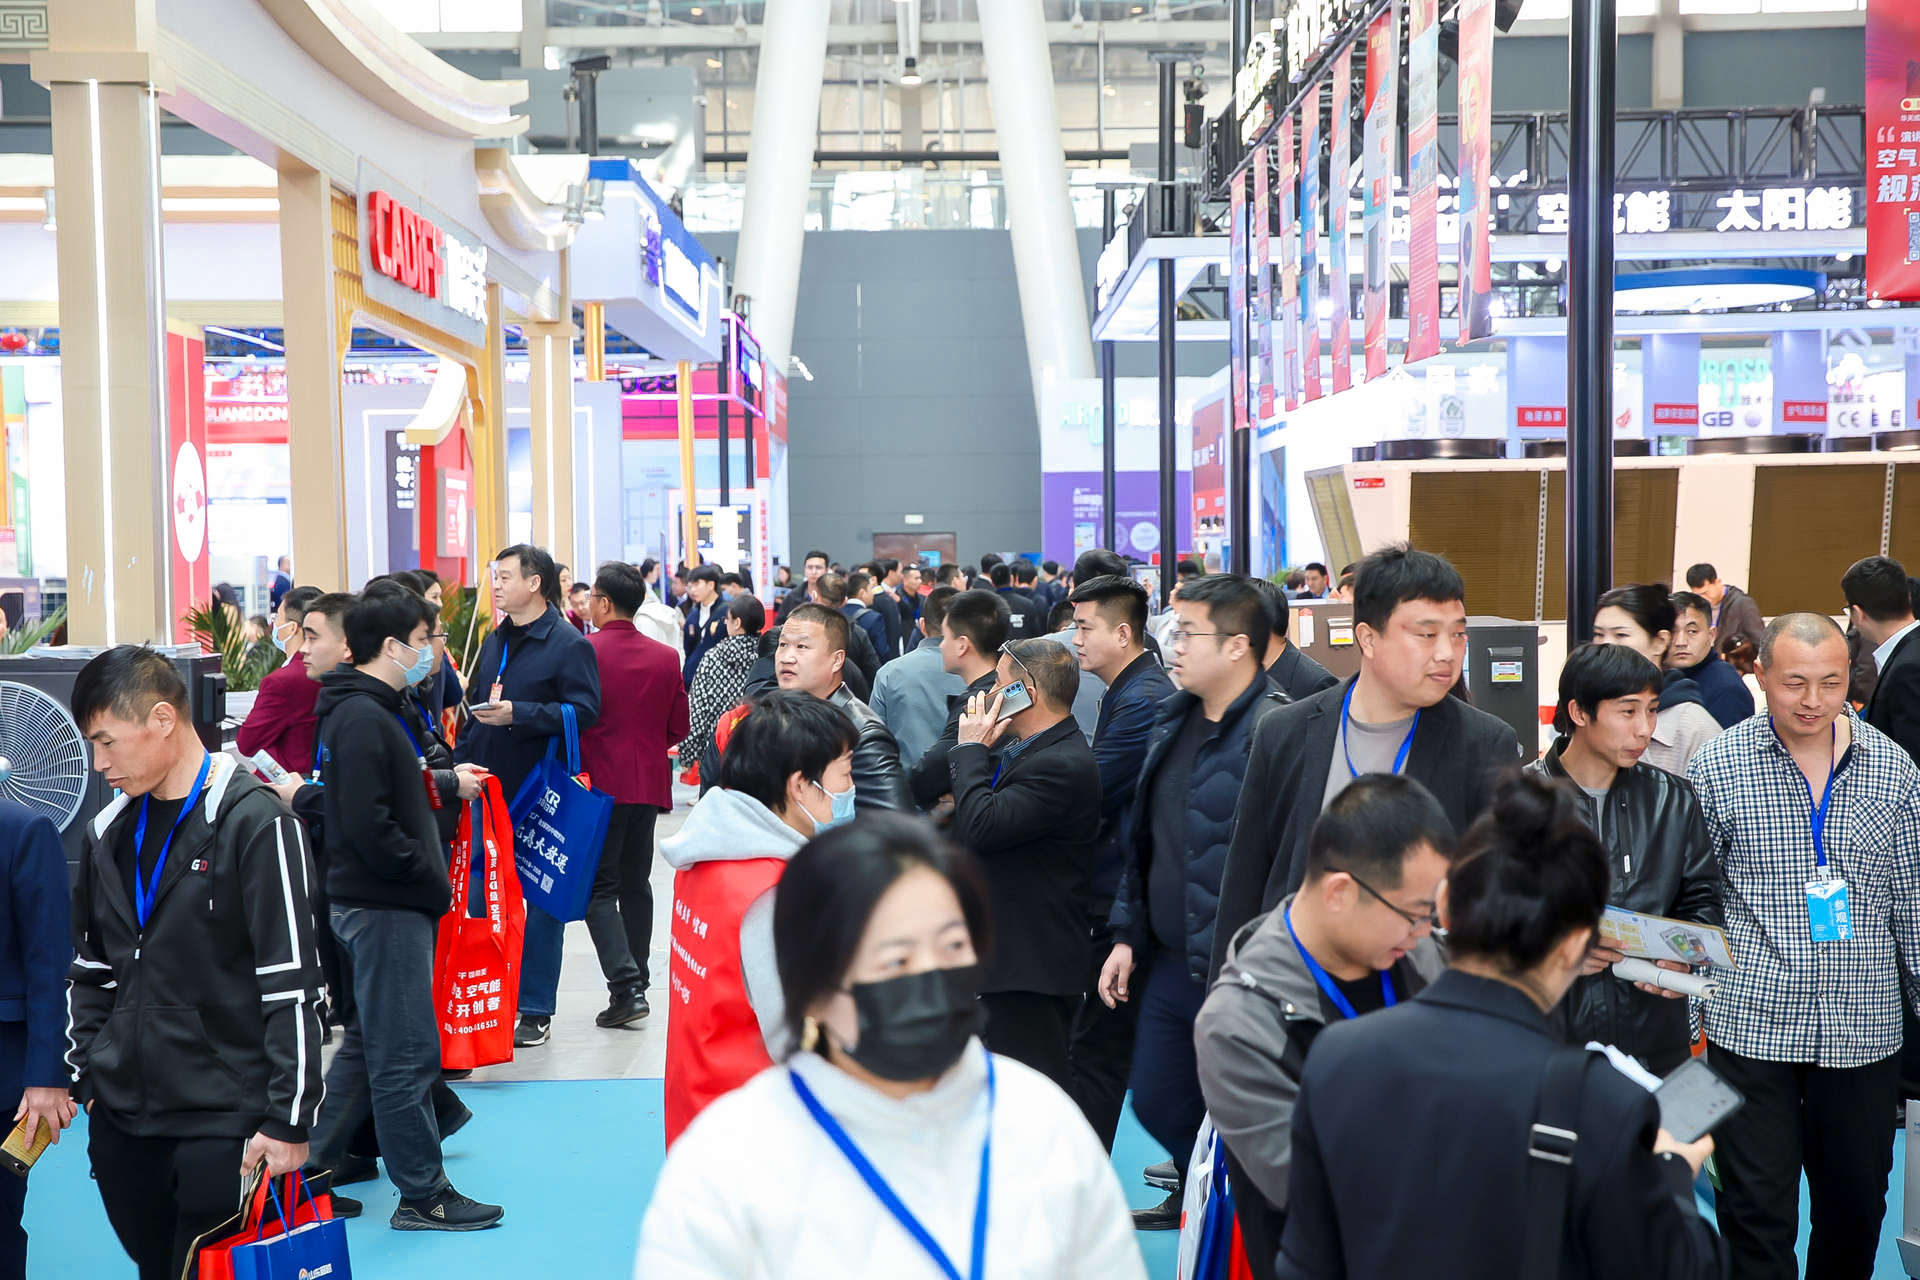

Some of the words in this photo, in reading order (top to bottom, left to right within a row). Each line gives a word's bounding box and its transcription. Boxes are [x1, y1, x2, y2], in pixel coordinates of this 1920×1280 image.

[1875, 148, 1920, 168] 空气
[1537, 190, 1670, 234] 空能
[1715, 186, 1852, 232] 太阳能
[1702, 411, 1734, 427] GB
[1834, 899, 1849, 939] 参观证
[466, 978, 501, 998] 空气能
